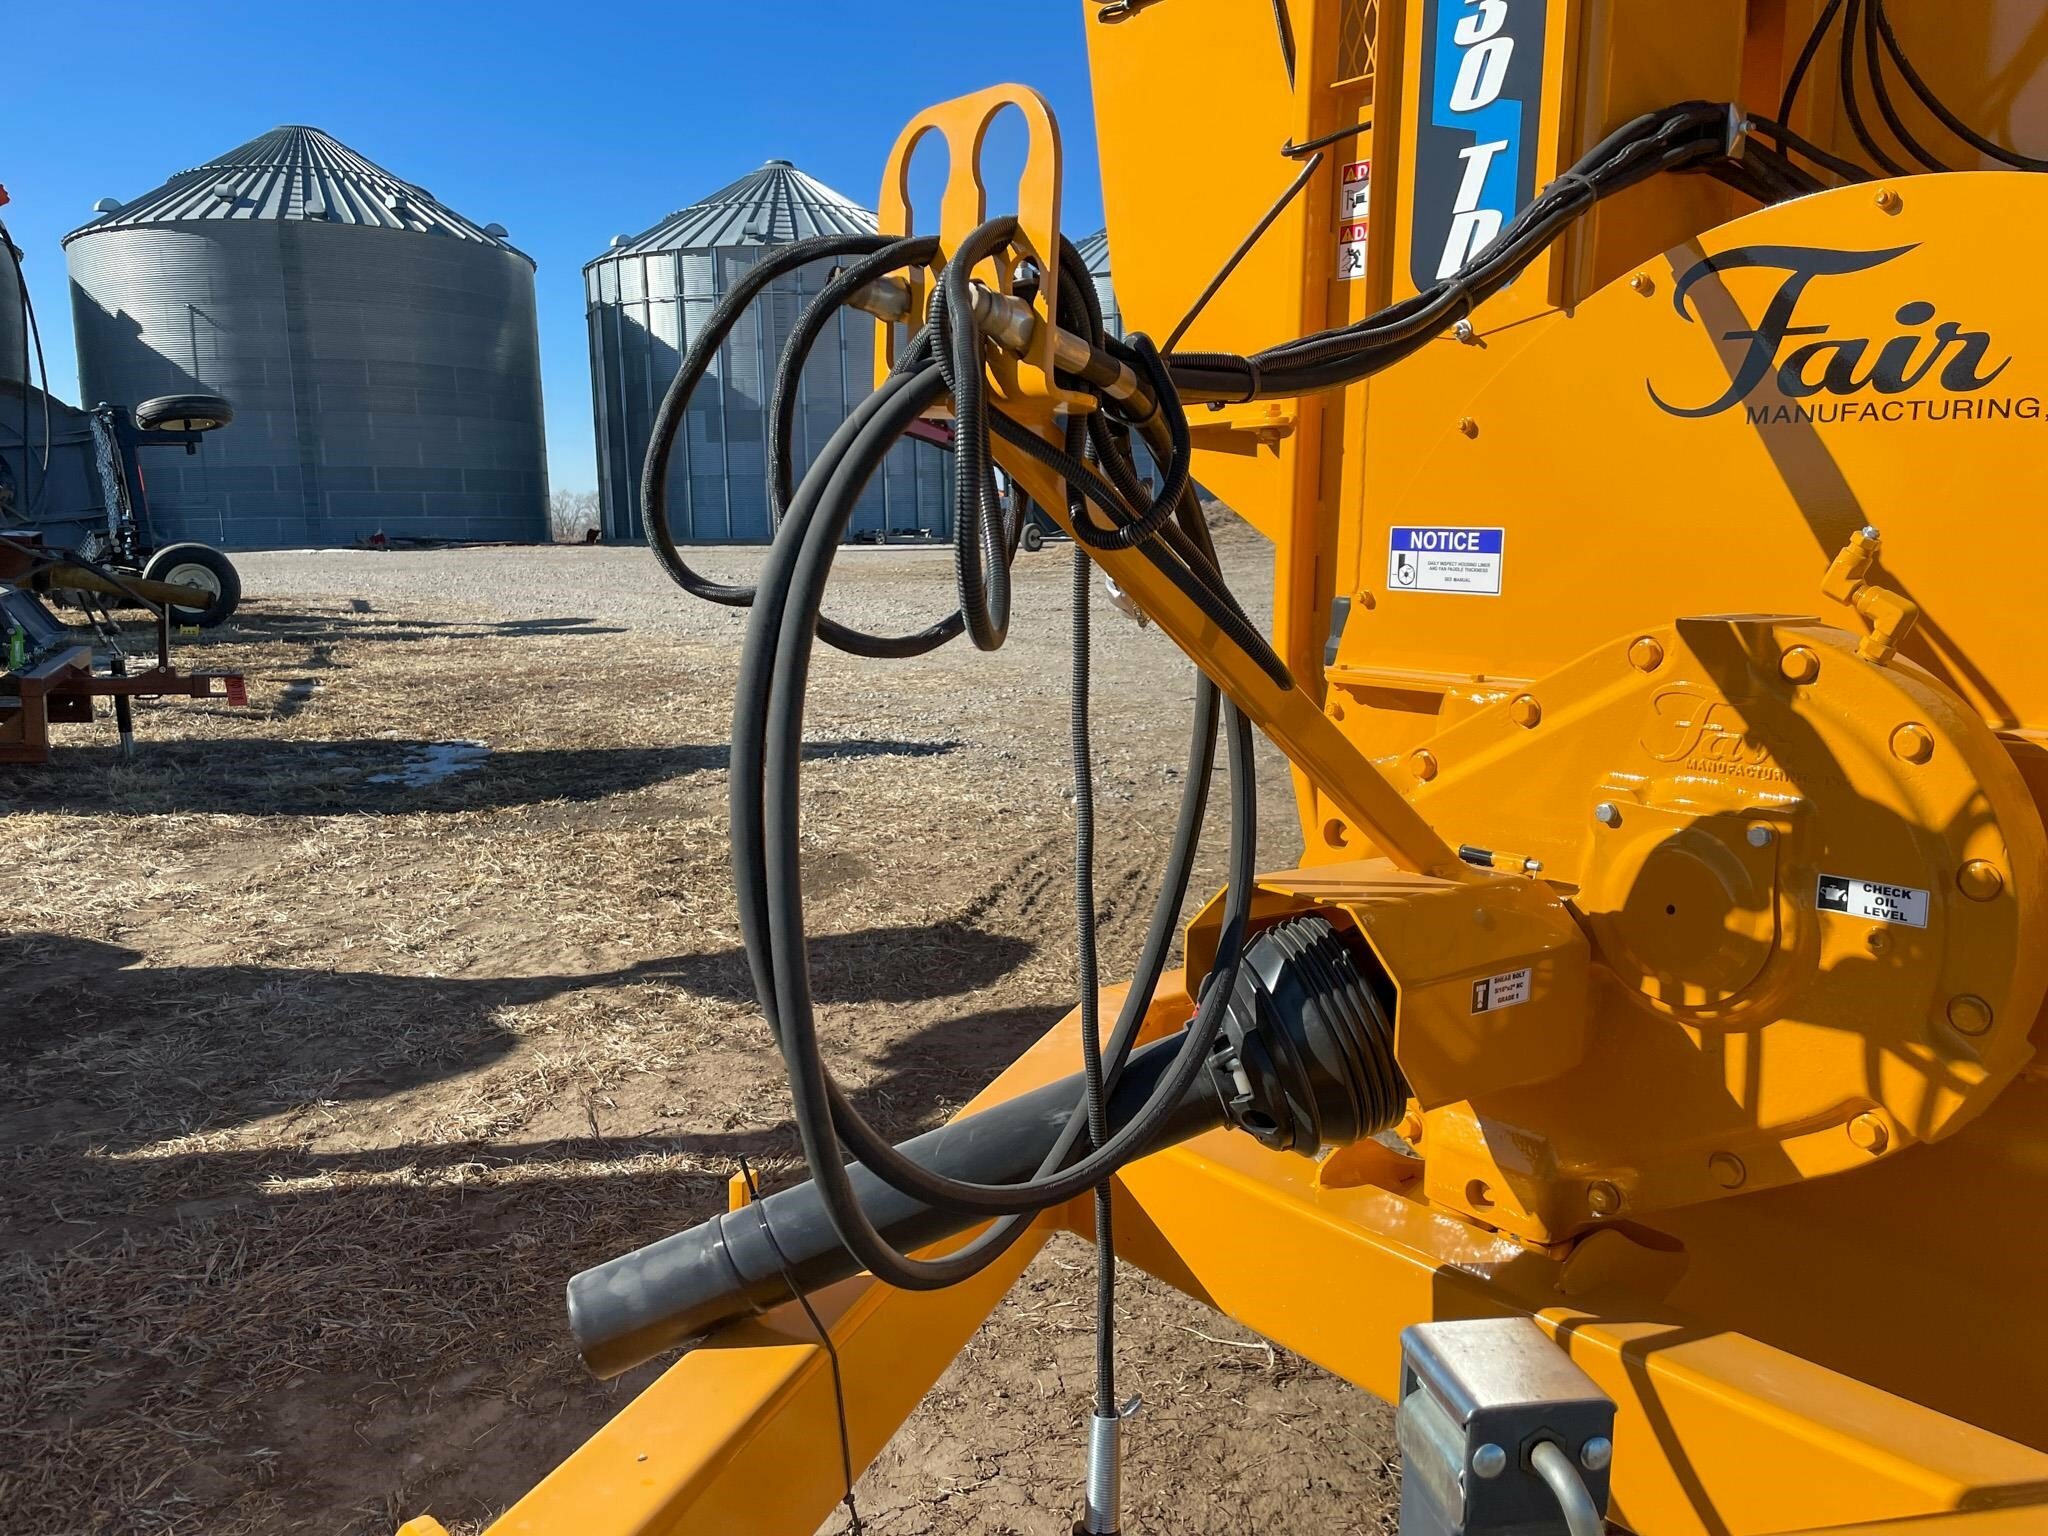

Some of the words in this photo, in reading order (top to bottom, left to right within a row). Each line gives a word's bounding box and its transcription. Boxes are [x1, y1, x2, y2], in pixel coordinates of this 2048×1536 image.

[1646, 241, 2013, 418] Fair
[1410, 531, 1480, 551] NOTICE
[1863, 883, 1912, 900] CHECK
[1875, 896, 1898, 909] OIL
[1863, 905, 1908, 921] LEVEL
